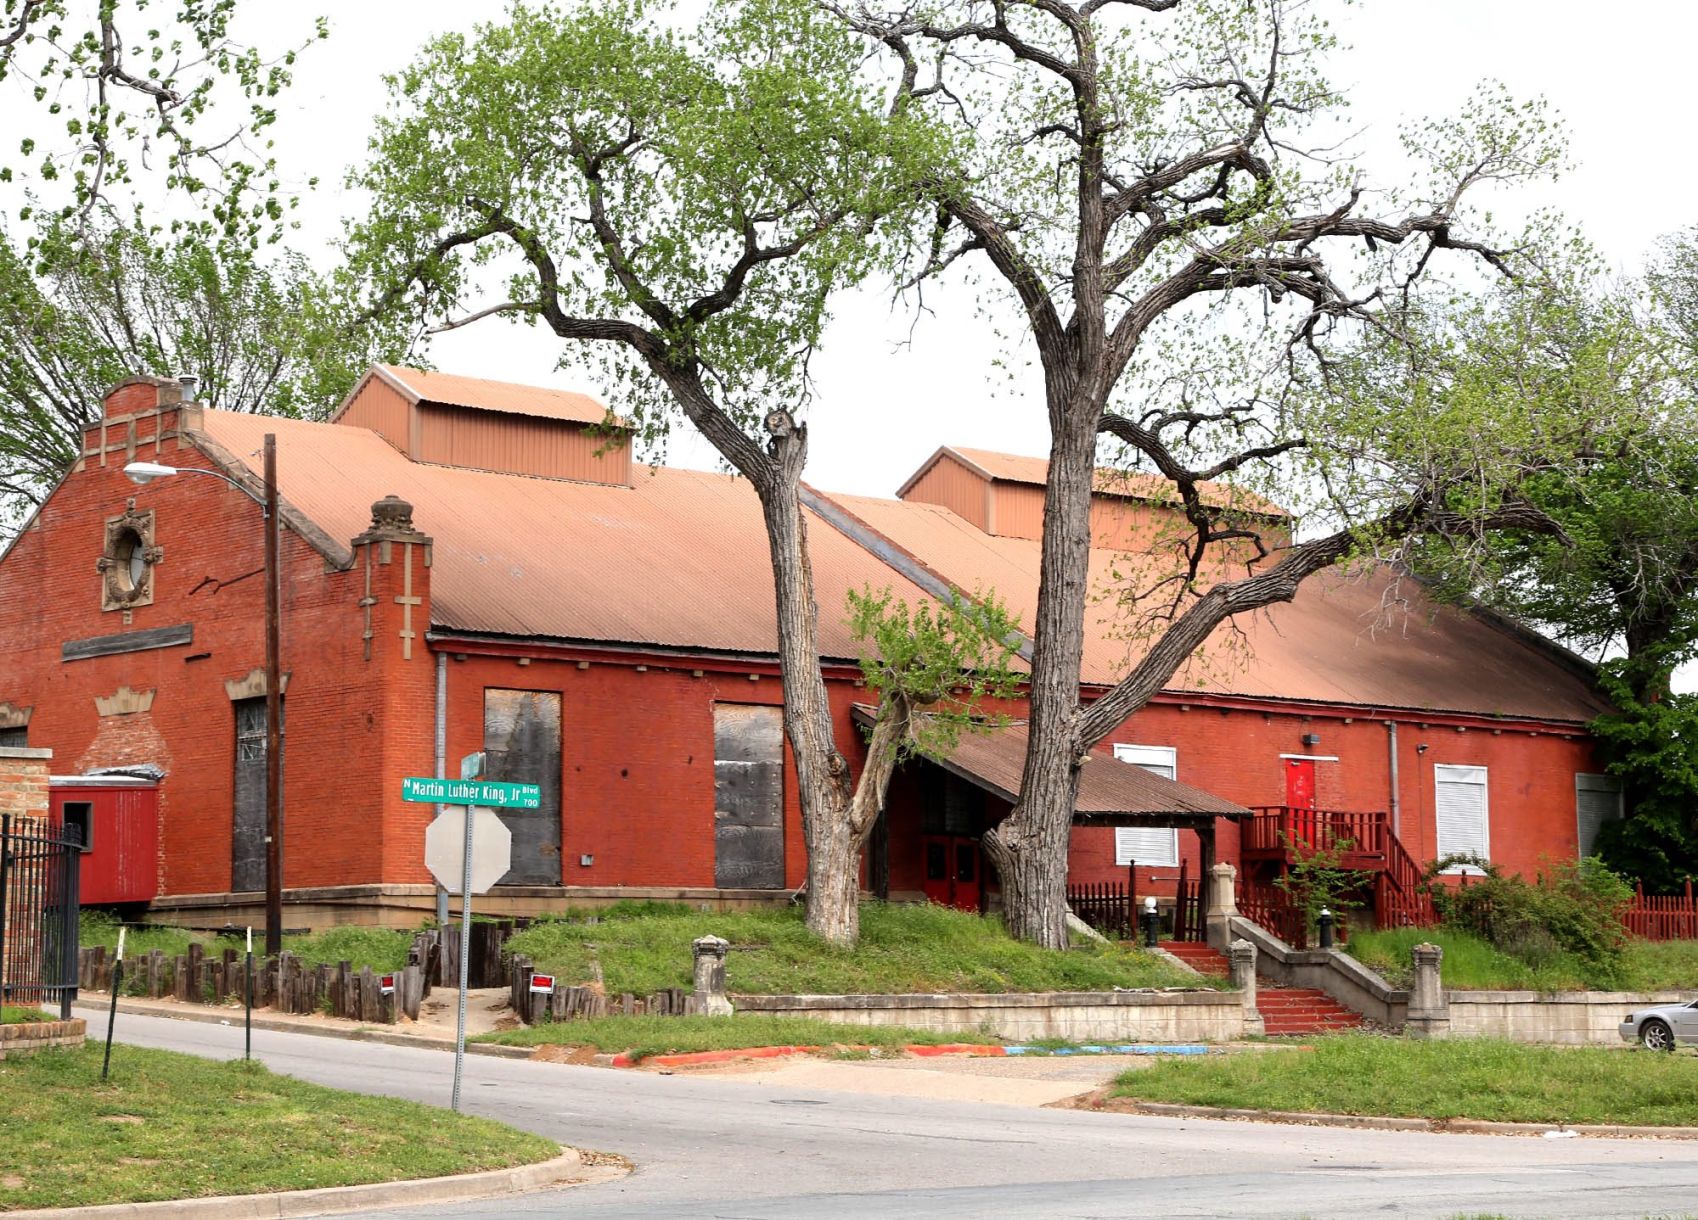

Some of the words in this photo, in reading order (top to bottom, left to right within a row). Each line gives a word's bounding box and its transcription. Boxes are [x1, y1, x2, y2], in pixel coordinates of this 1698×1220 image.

[404, 779, 411, 788] N
[412, 781, 444, 797] Martin
[448, 784, 479, 799] Luther
[483, 785, 508, 804] King,
[511, 787, 521, 801] Jr
[522, 786, 538, 794] Blvd
[523, 798, 538, 807] 700
